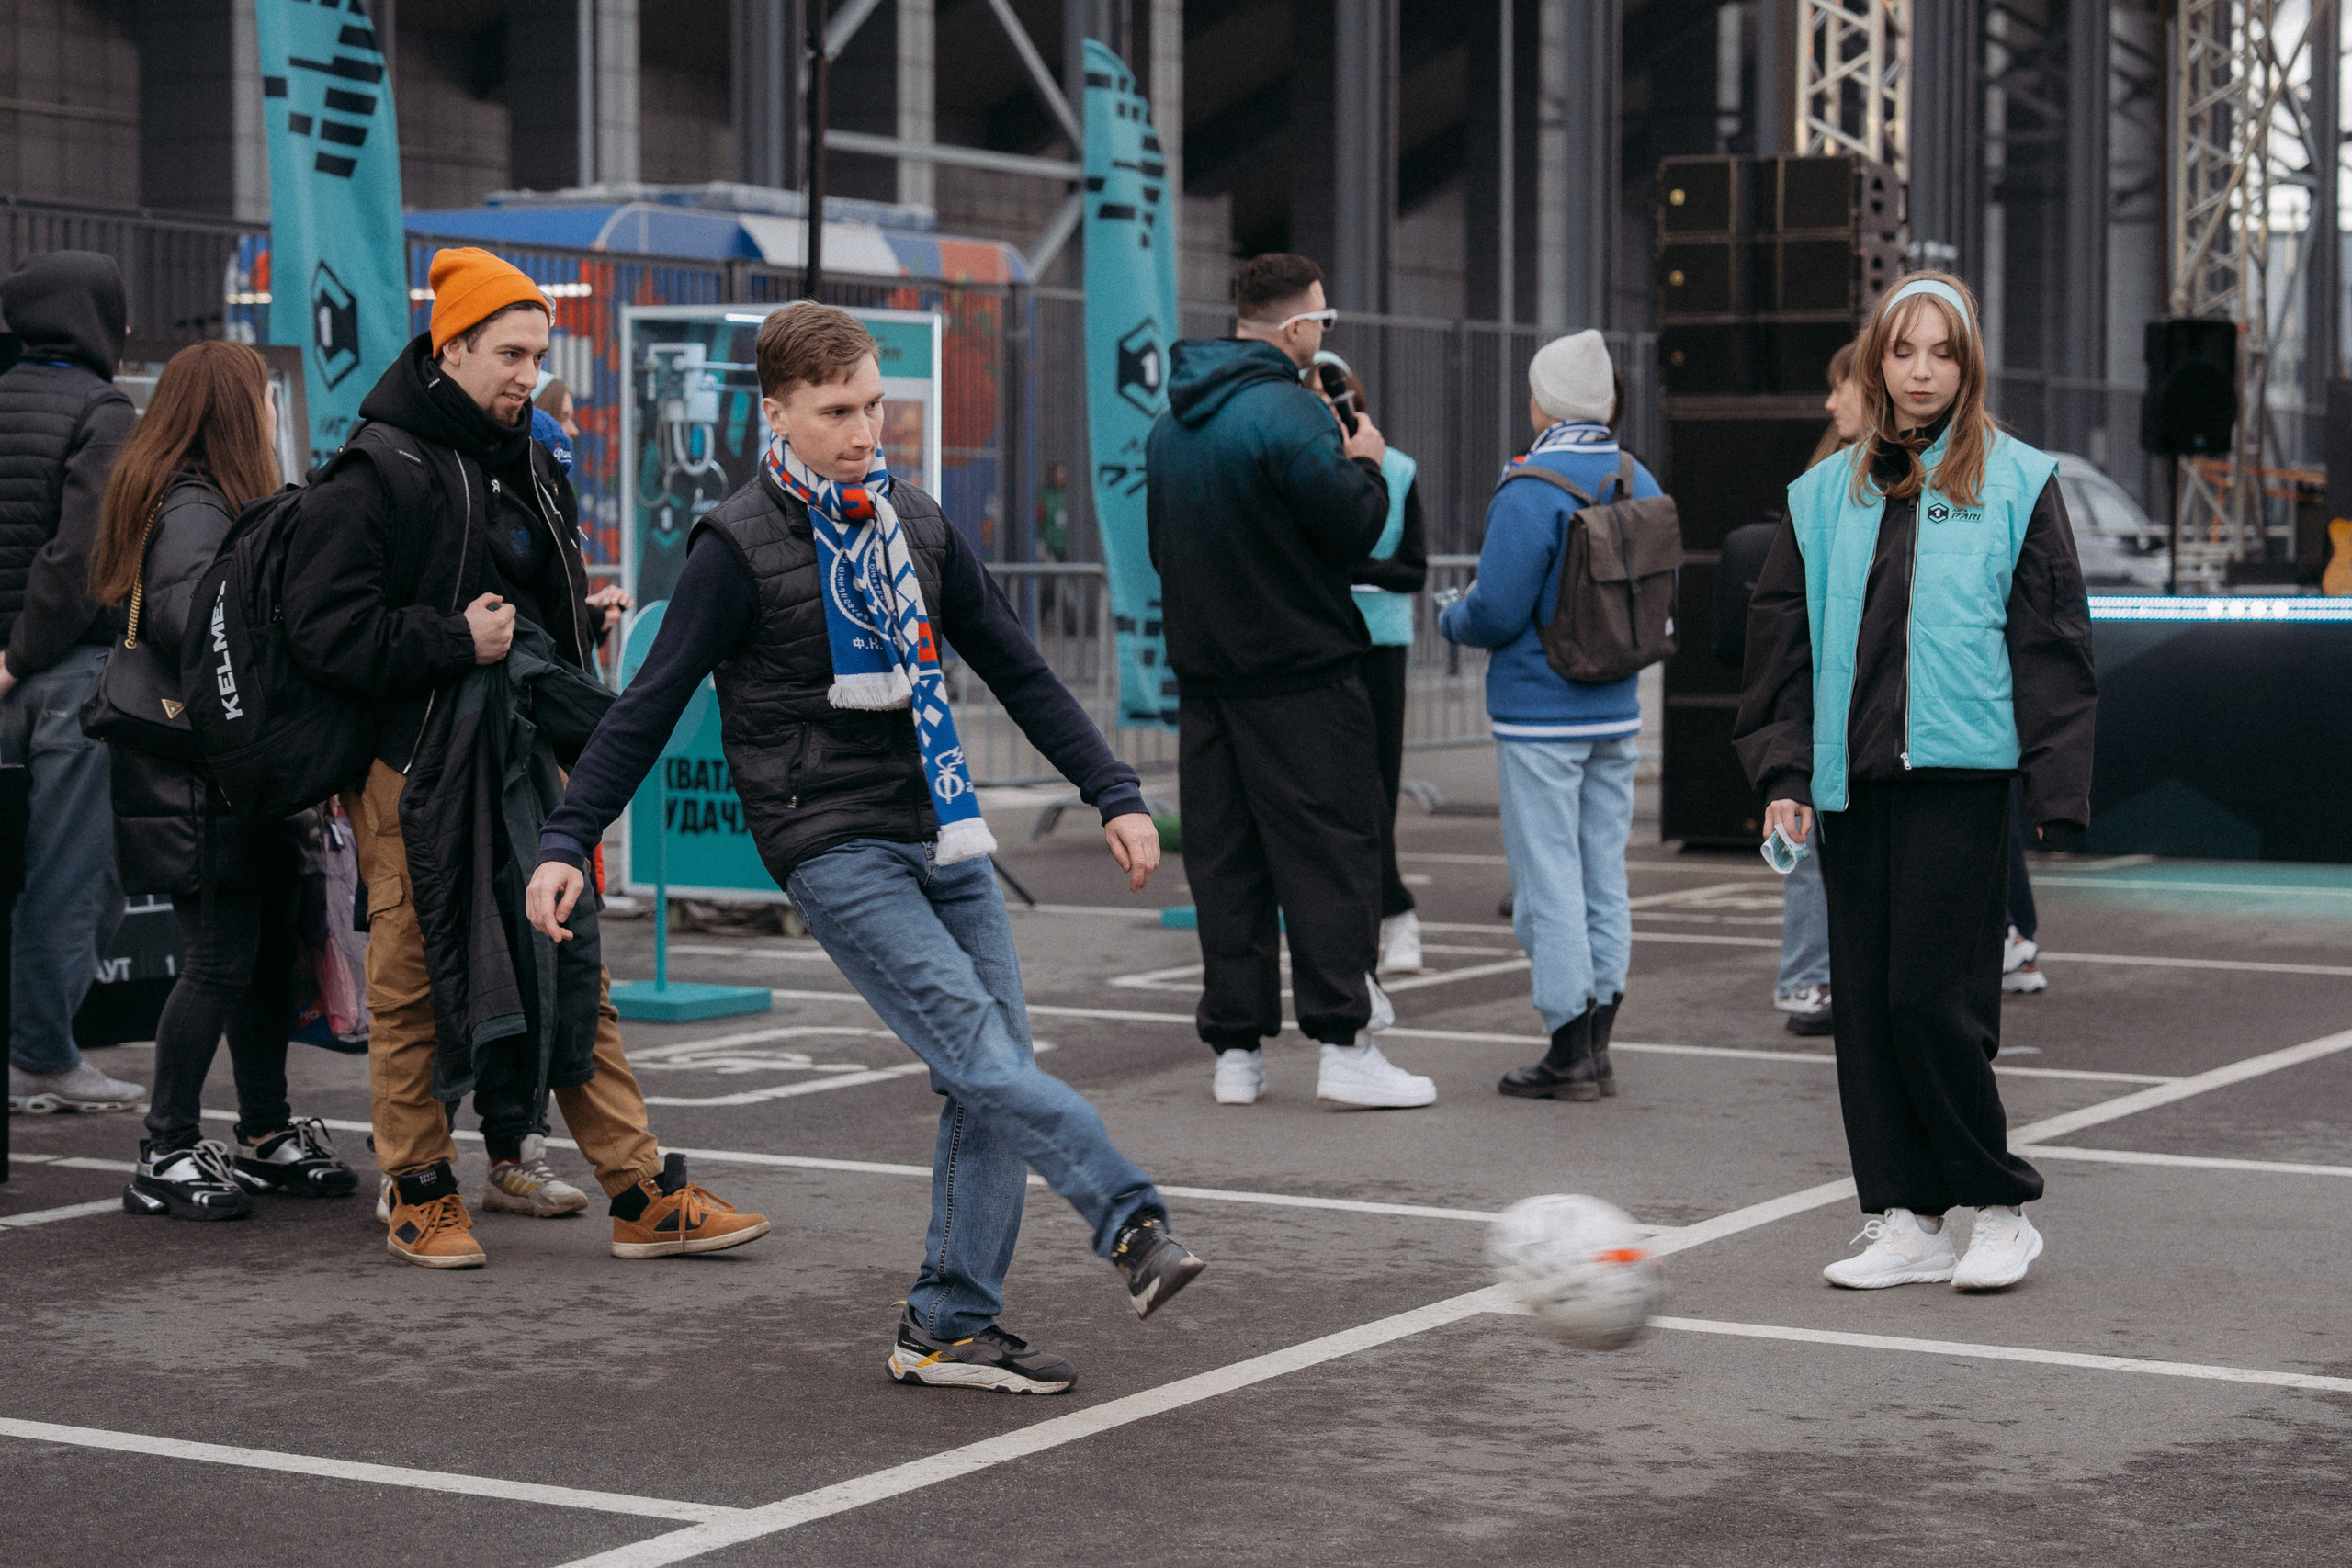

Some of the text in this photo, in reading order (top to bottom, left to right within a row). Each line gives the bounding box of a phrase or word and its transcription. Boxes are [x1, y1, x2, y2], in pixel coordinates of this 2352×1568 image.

[1141, 351, 1159, 386] 1
[1934, 509, 1941, 517] 1
[1951, 513, 1982, 521] PARI
[210, 600, 243, 721] KELME
